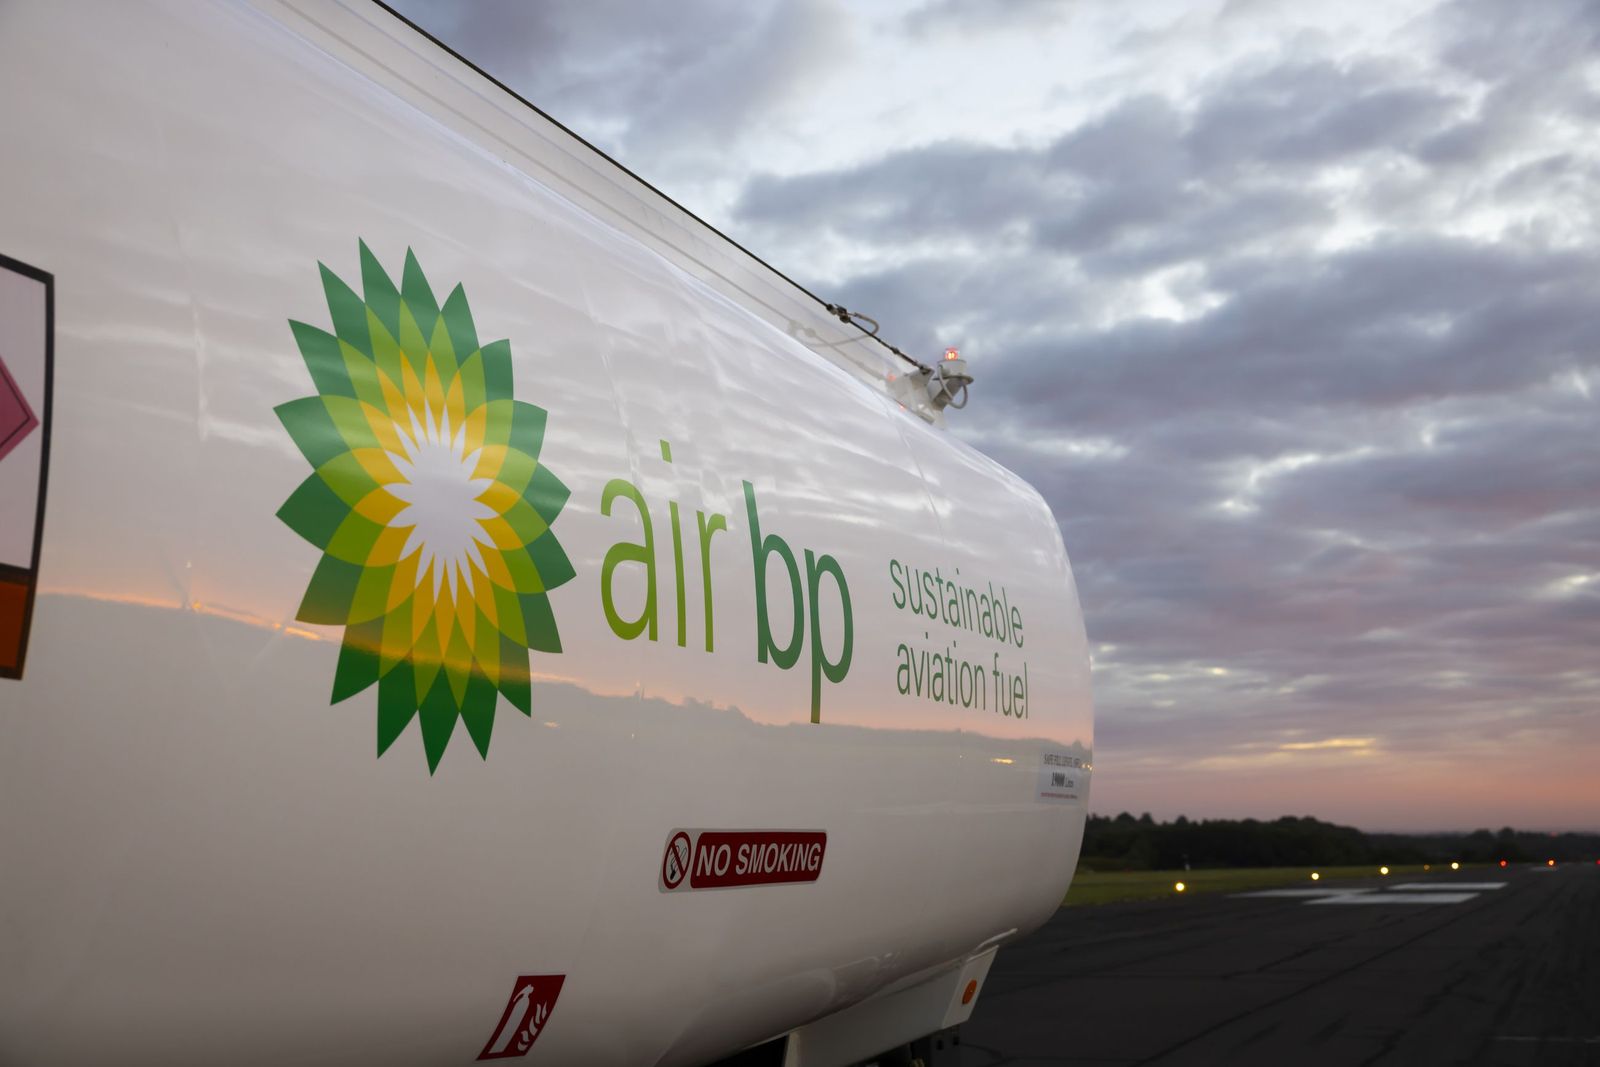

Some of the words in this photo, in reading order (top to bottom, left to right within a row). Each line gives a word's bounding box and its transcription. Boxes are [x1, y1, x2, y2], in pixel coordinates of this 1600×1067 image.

[600, 439, 727, 654] air
[742, 479, 854, 724] bp
[889, 558, 1024, 649] sustainable
[896, 631, 986, 711] aviation
[992, 652, 1029, 720] fuel
[695, 843, 732, 877] NO
[735, 842, 822, 876] SMOKING
